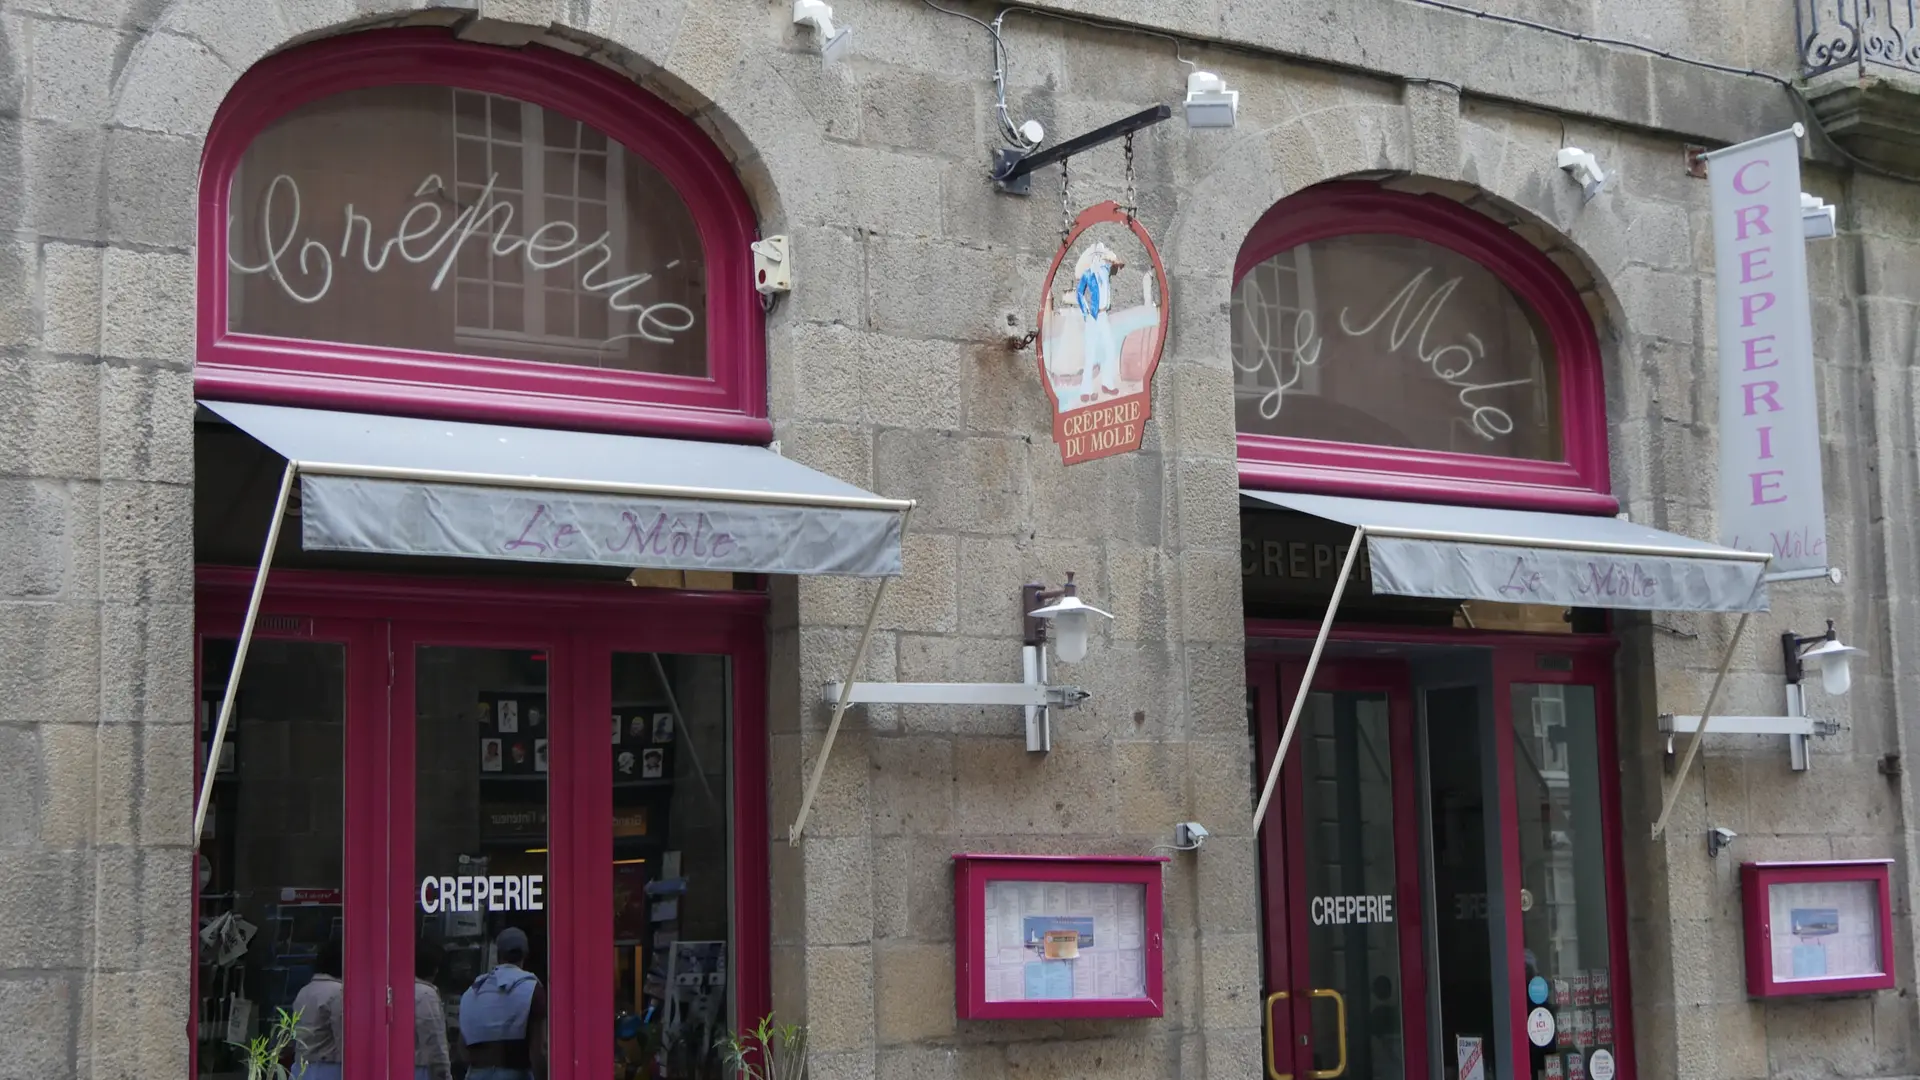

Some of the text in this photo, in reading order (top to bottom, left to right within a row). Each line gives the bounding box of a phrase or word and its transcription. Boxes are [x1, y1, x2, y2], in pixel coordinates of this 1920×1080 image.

[1732, 158, 1788, 507] CREPERIE
[1063, 400, 1141, 437] CRÊPERIE
[1065, 423, 1136, 459] DU MOLE
[503, 503, 738, 559] Le Môle
[1769, 525, 1826, 561] Môle
[1498, 555, 1658, 598] Le Môle
[420, 874, 544, 914] CREPERIE
[1311, 894, 1393, 926] CREPERIE
